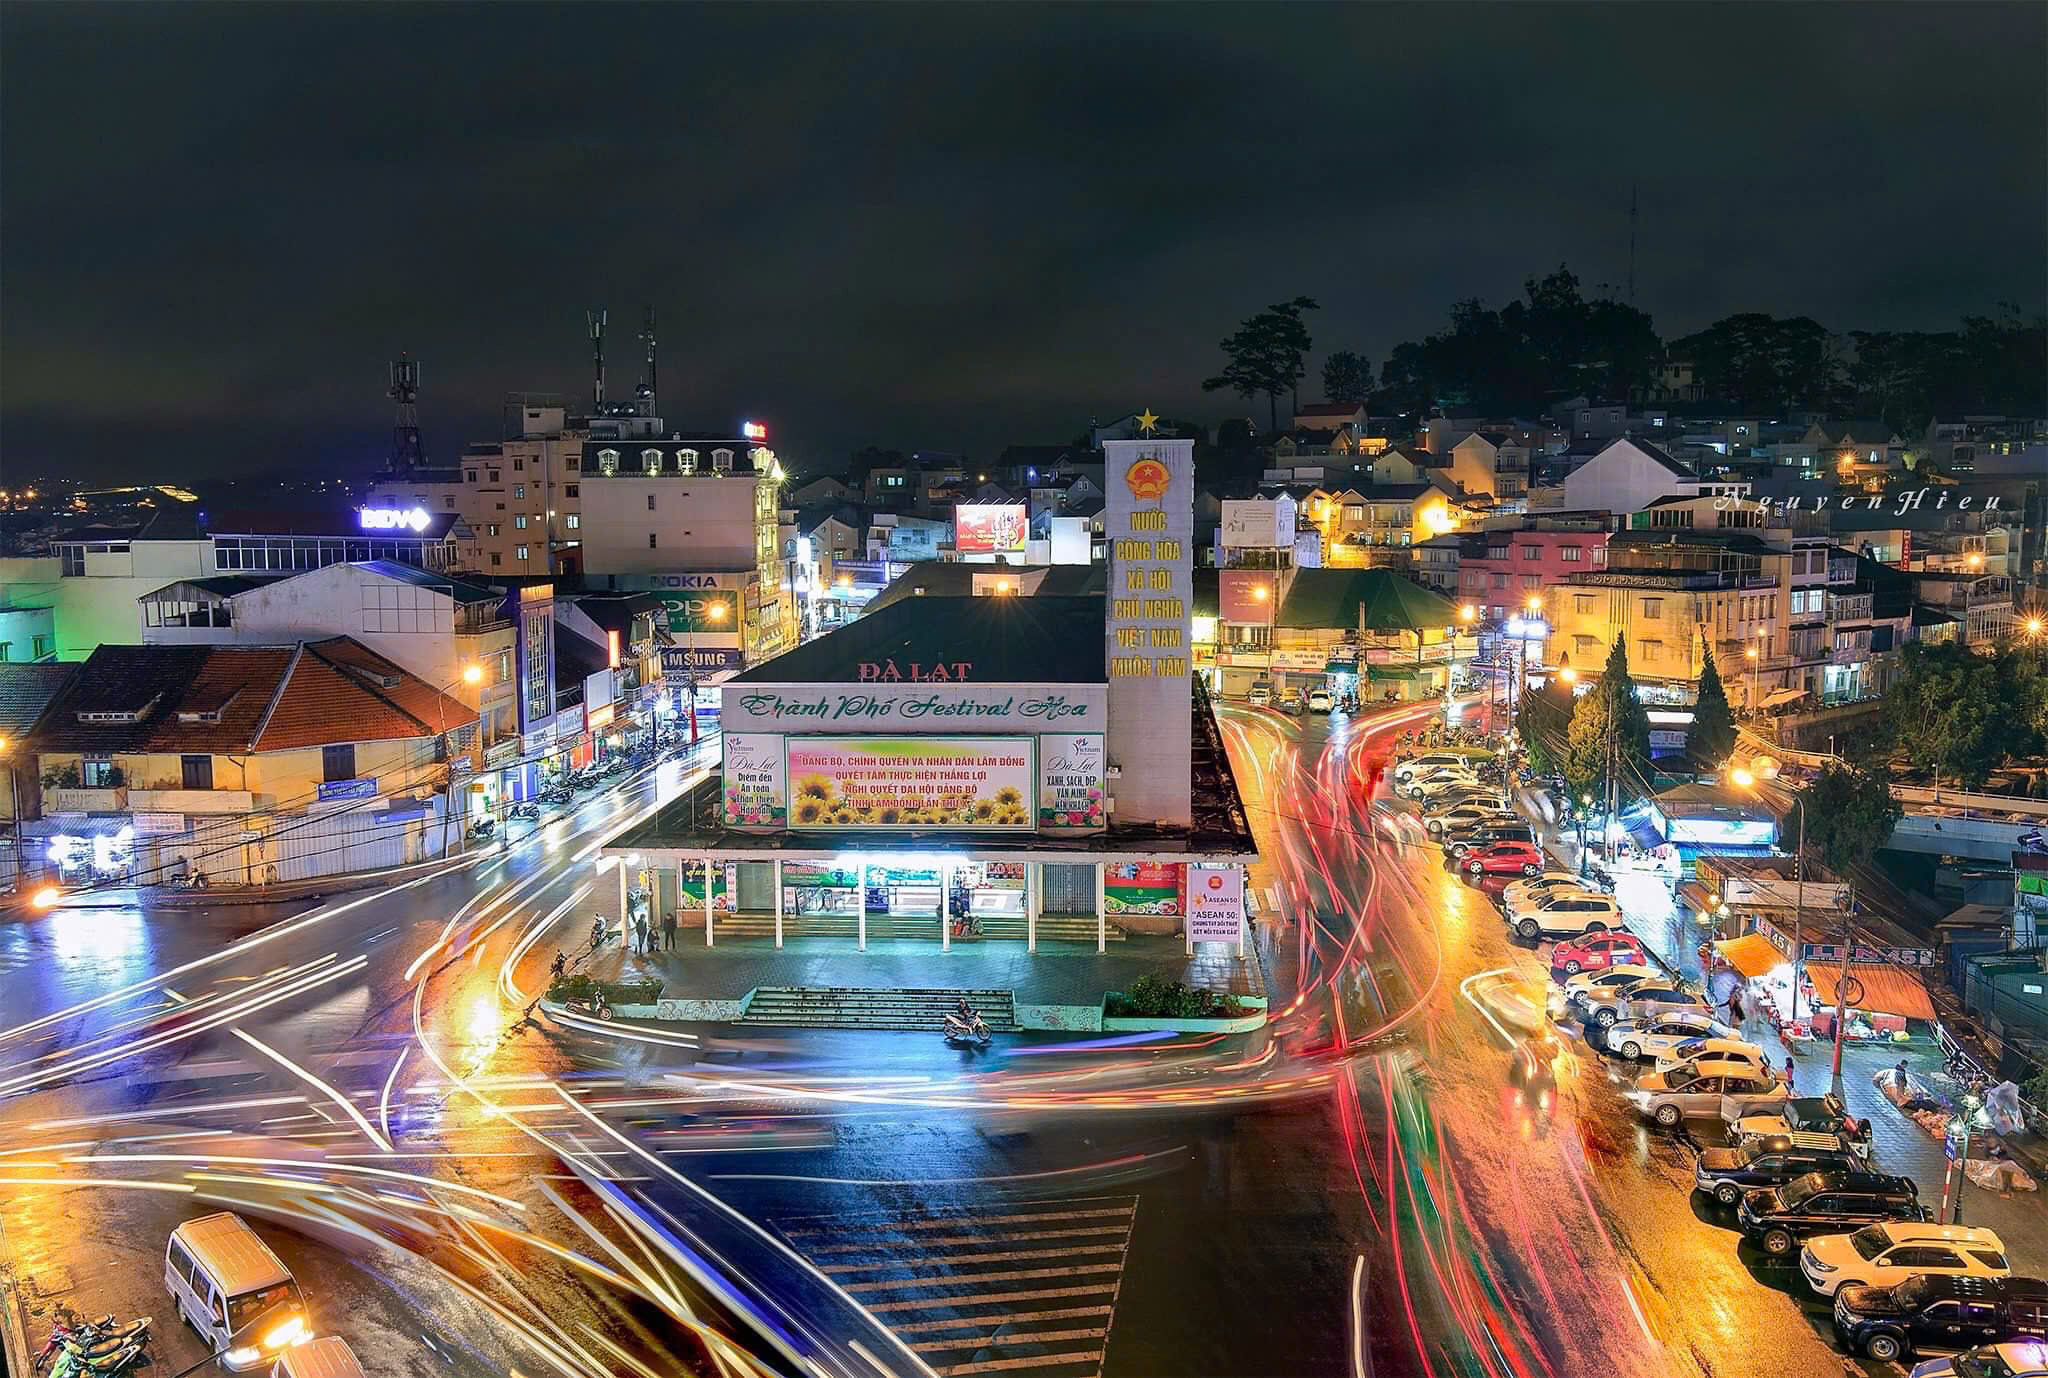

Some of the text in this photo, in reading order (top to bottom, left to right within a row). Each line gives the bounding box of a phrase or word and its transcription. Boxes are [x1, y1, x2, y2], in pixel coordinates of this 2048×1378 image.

[649, 575, 718, 588] NOKIA
[1152, 628, 1180, 648] NAM
[900, 695, 1013, 718] Festival
[1018, 696, 1088, 720] Hoa
[1772, 933, 1786, 949] 45
